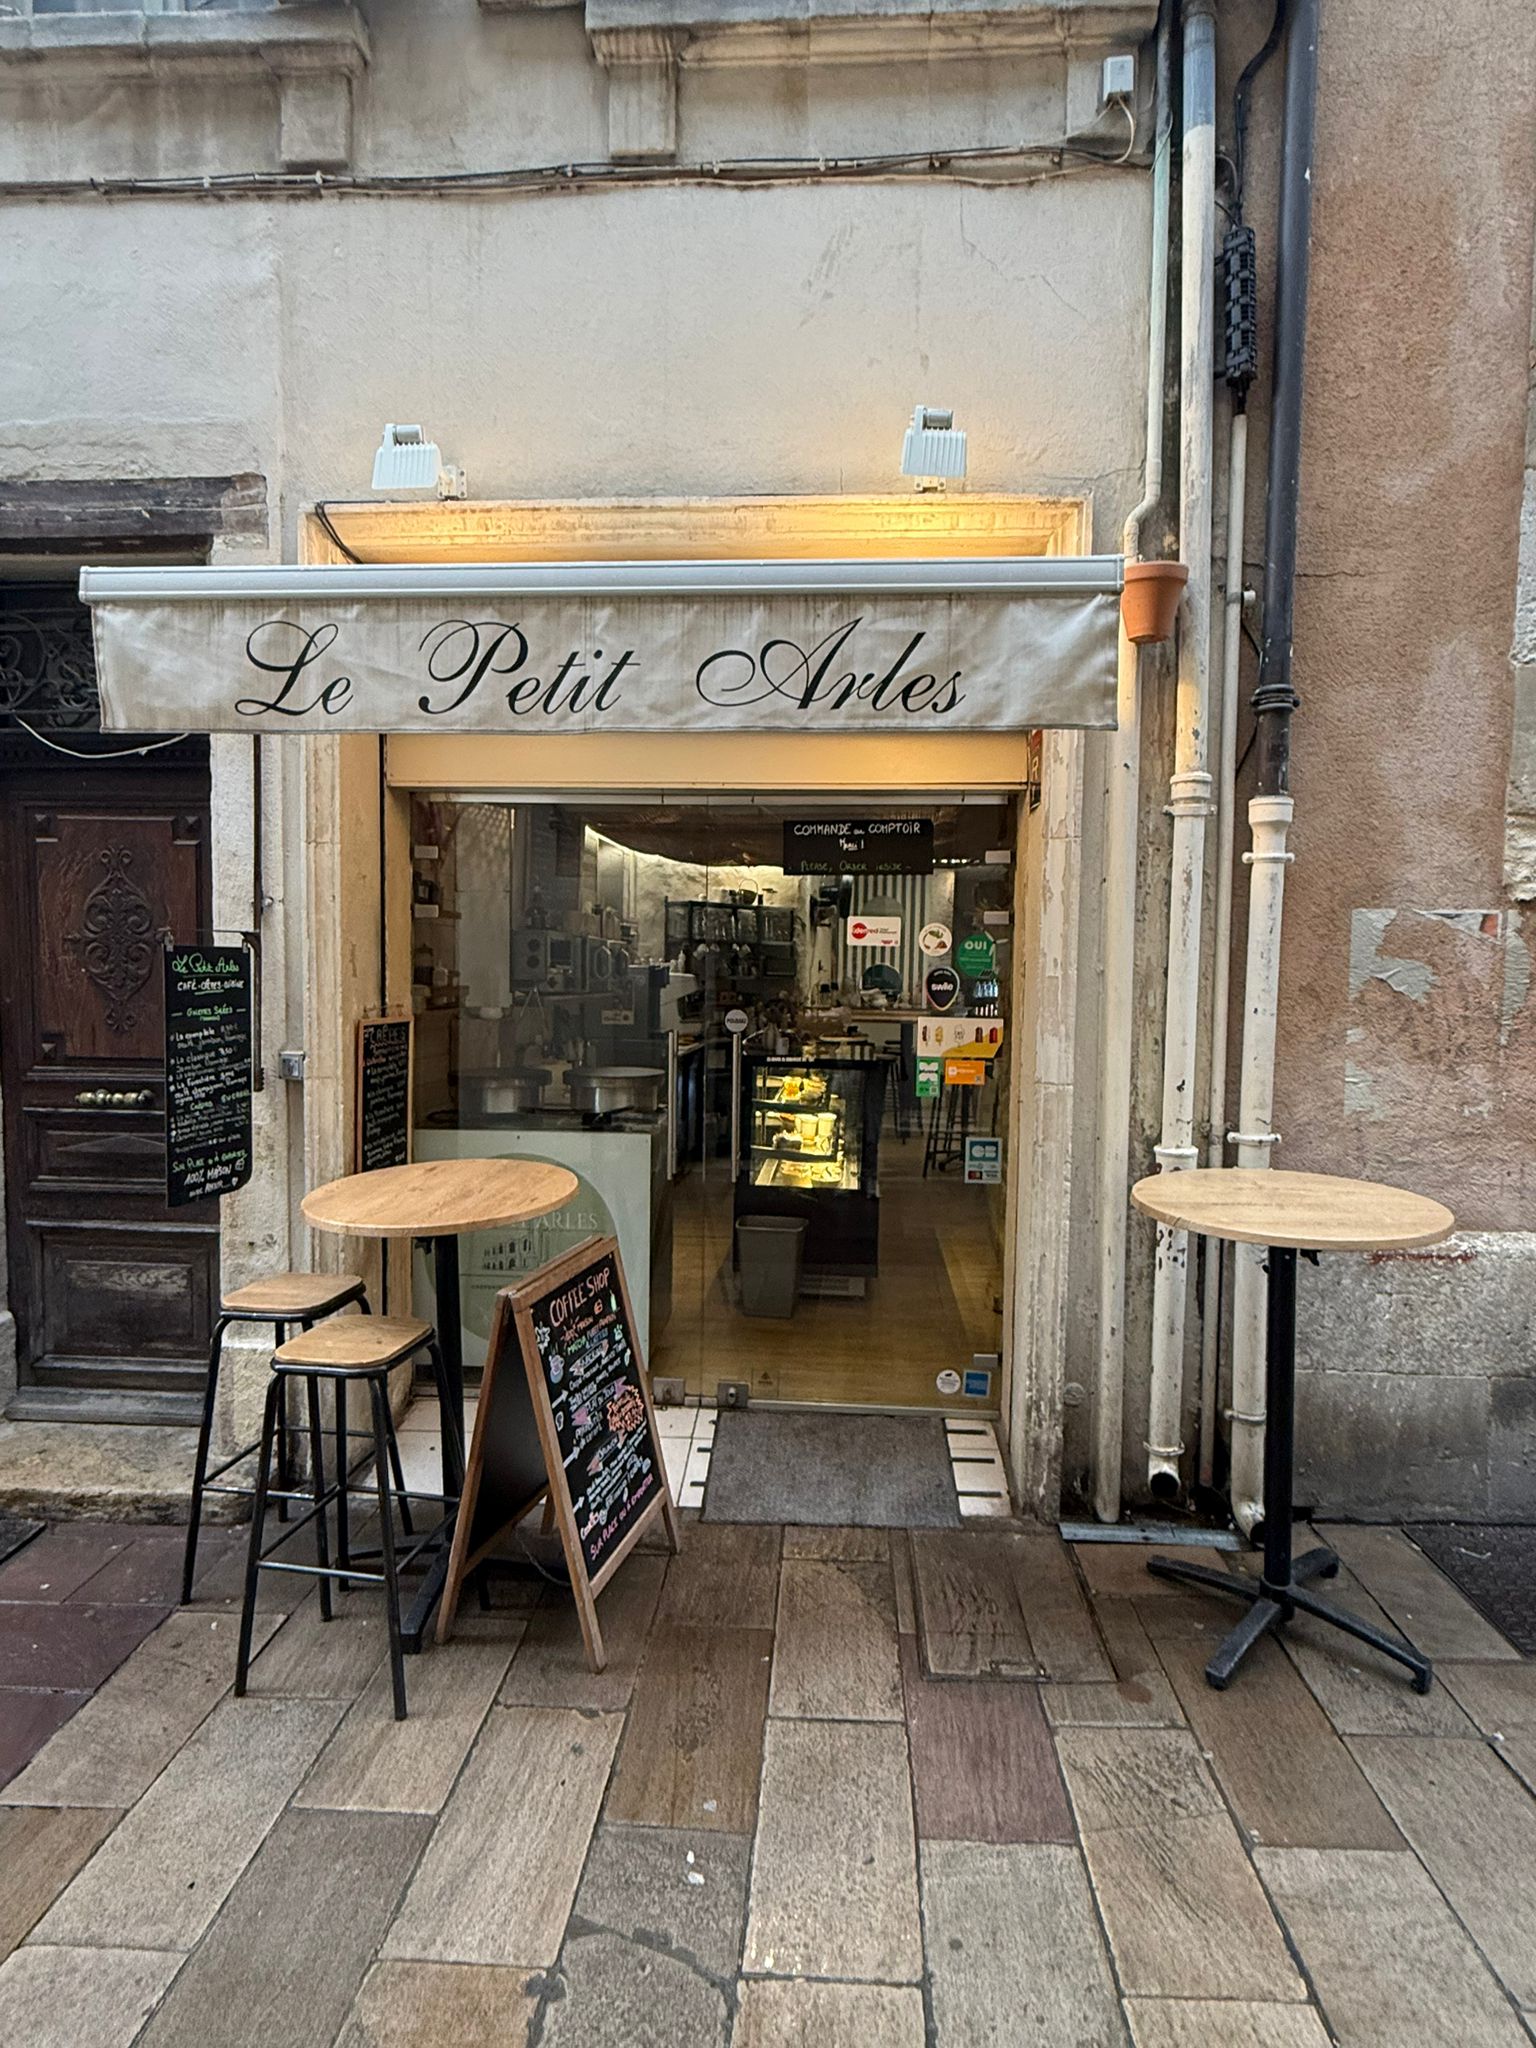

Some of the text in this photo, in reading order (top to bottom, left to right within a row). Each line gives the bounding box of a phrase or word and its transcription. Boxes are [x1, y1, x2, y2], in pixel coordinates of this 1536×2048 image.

[234, 615, 966, 719] Le Petit Arles
[964, 940, 987, 950] OUI
[550, 1282, 587, 1327] COFFEE
[586, 1267, 610, 1297] SHOP
